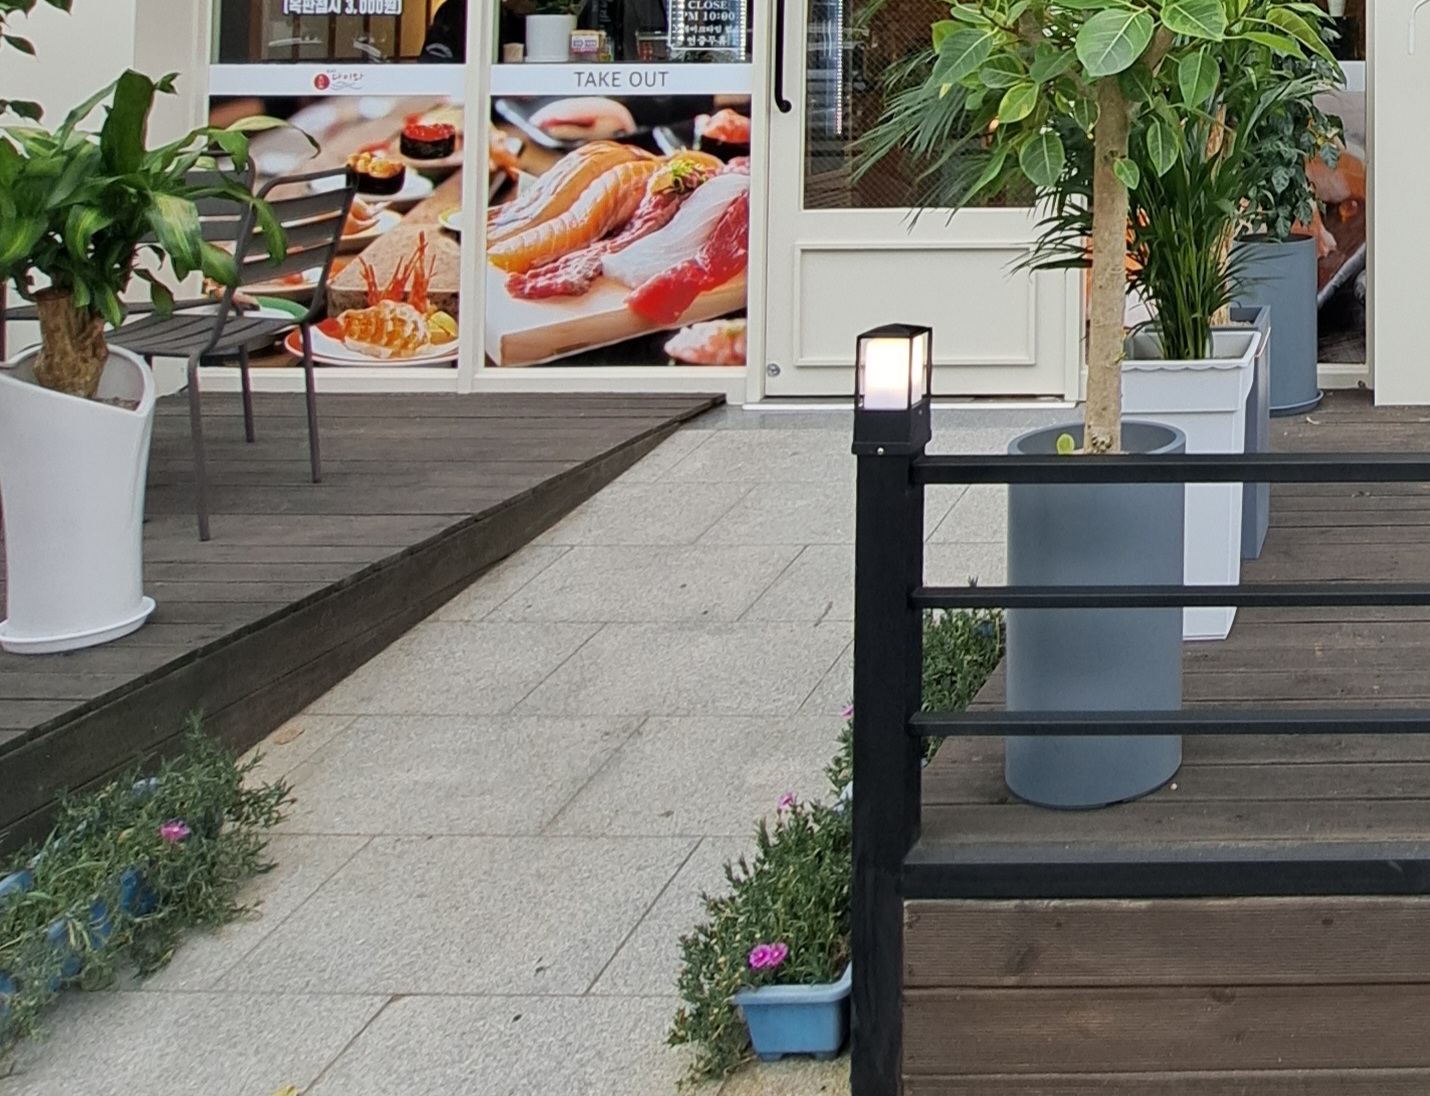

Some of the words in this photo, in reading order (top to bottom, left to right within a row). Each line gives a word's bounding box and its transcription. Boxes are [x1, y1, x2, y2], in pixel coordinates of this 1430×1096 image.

[688, 0, 727, 10] CLOSE
[703, 11, 735, 21] 10:00
[574, 71, 621, 87] TAKE
[629, 71, 669, 87] OUT
